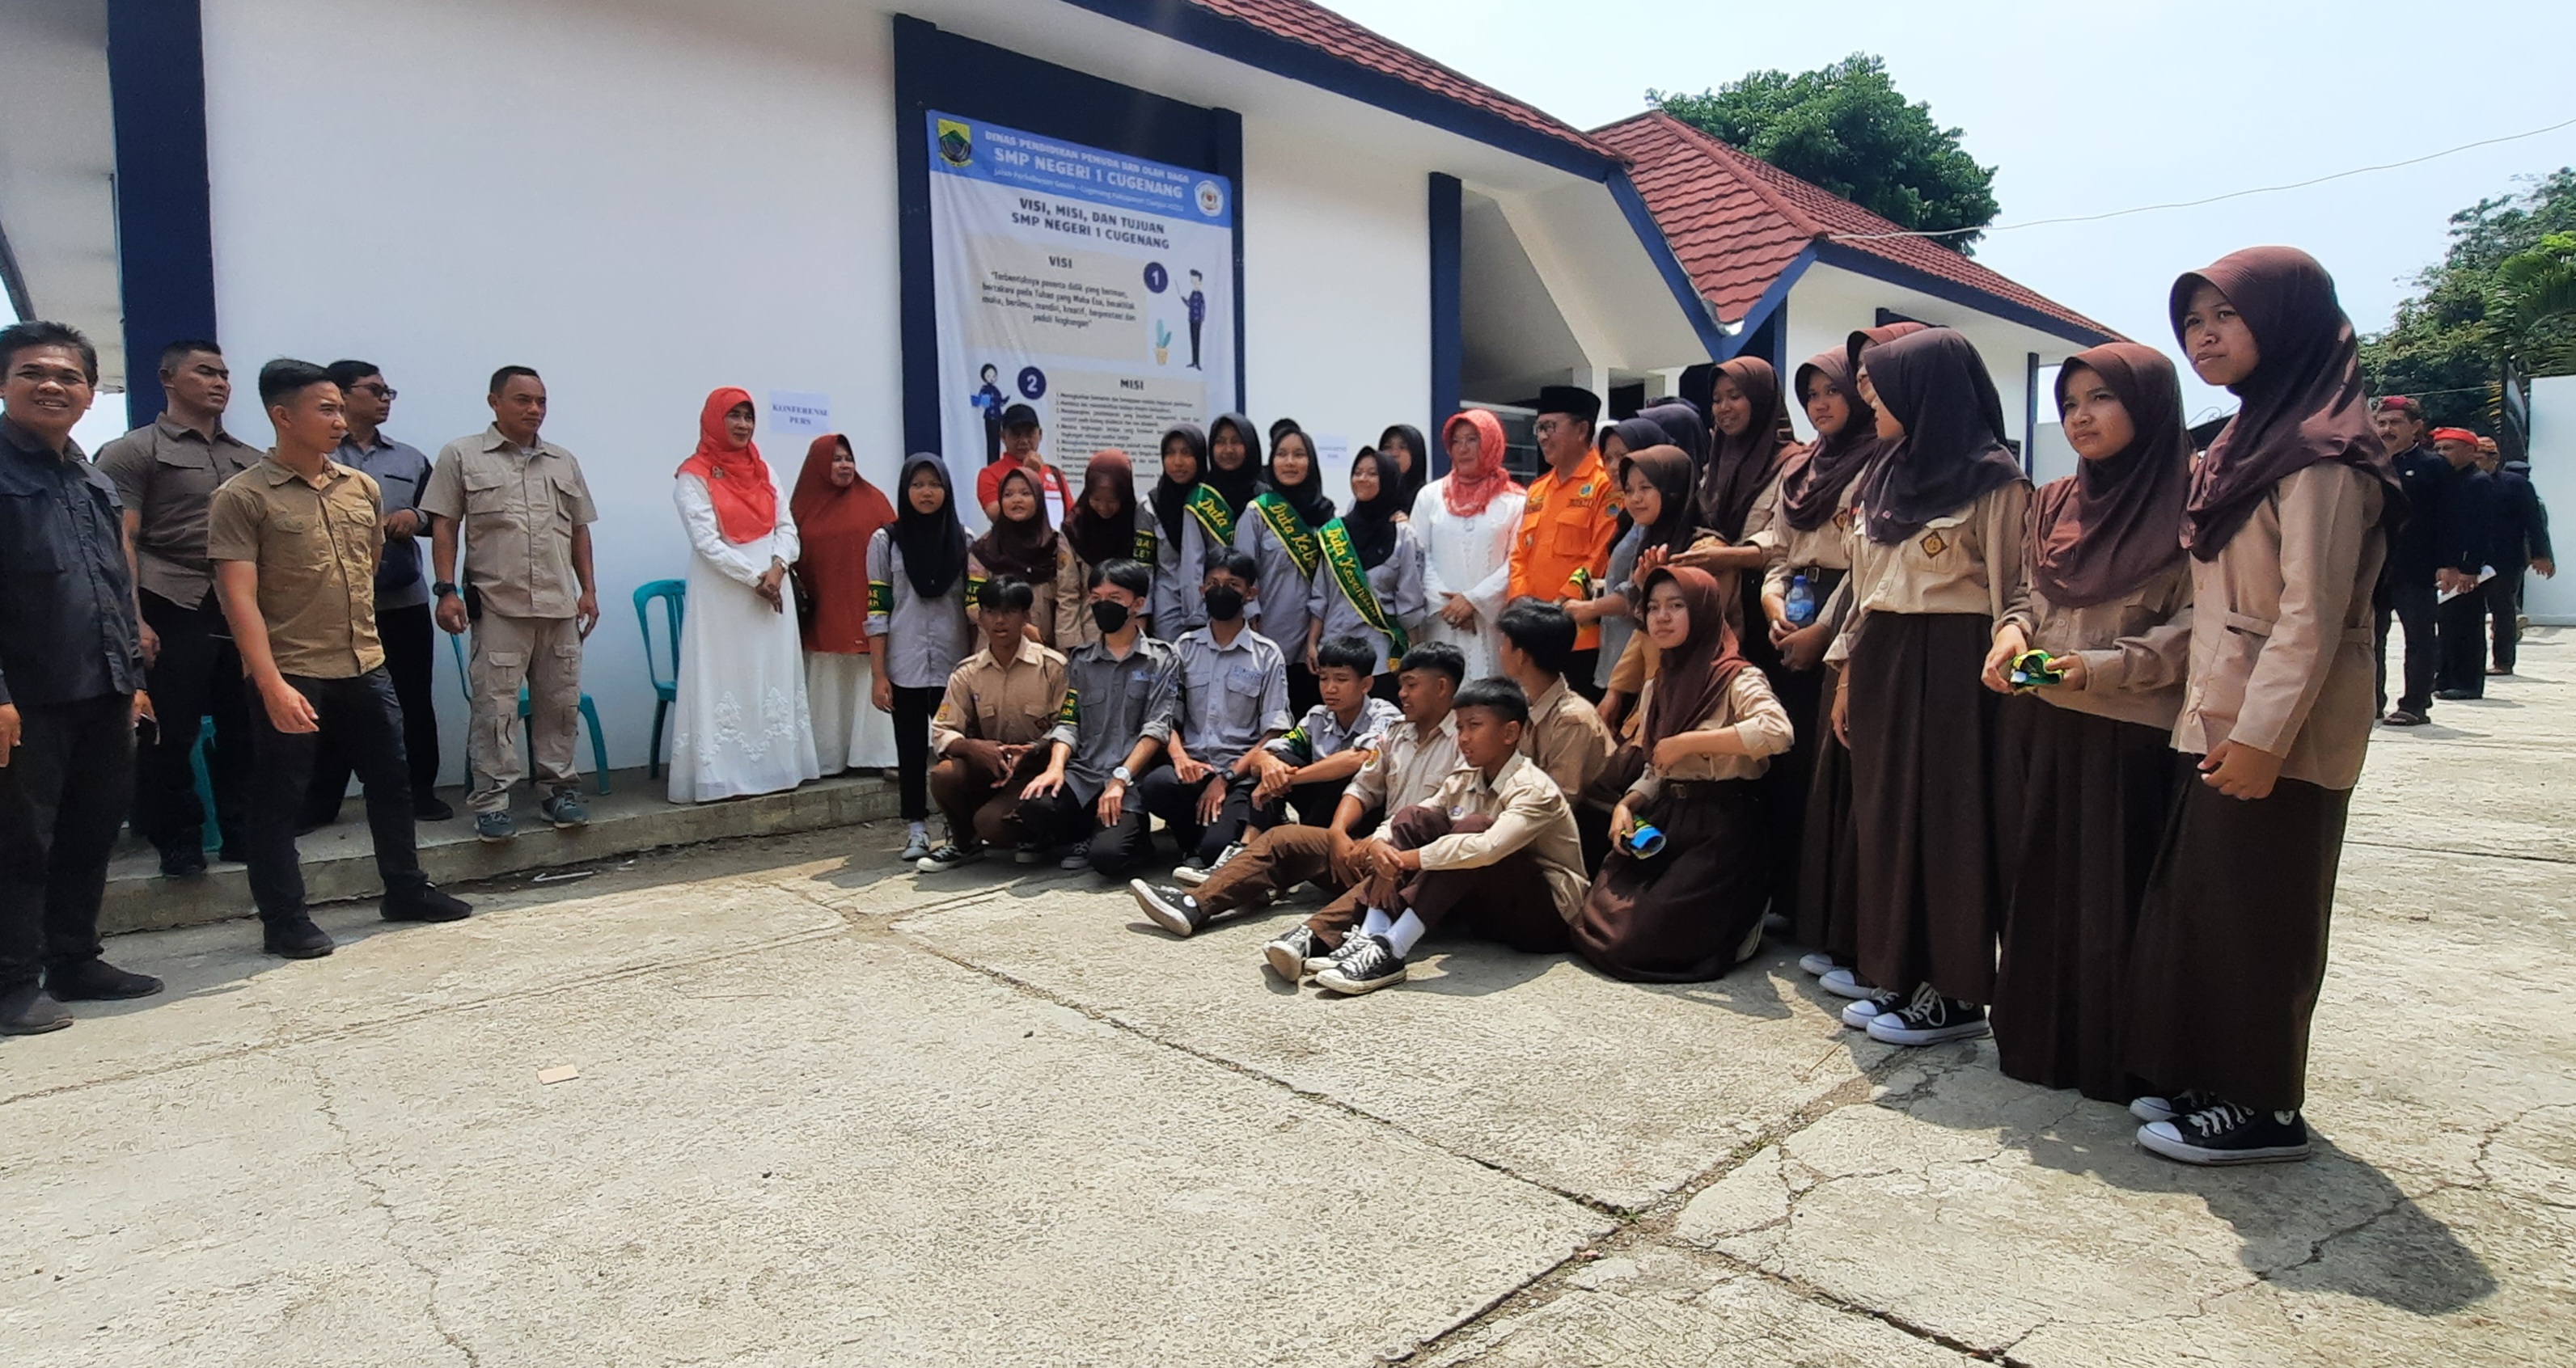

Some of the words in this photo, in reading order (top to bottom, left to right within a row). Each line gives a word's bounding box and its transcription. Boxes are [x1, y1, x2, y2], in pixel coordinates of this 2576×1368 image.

[994, 147, 1030, 167] SMP
[1034, 155, 1090, 179] NEGERI
[1096, 169, 1102, 182] 1
[1107, 171, 1183, 198] CUGENANG
[1019, 198, 1051, 215] VISI,
[1055, 205, 1088, 222] MISI,
[1092, 212, 1117, 225] DAN
[1121, 217, 1165, 234] TUJUAN
[1012, 213, 1039, 226] SMP
[1045, 218, 1091, 236] NEGERI
[1096, 227, 1101, 237] 1
[1106, 229, 1170, 249] CUGENANG
[1048, 255, 1072, 268] VISI
[1152, 269, 1159, 286] 1
[1027, 374, 1038, 392] 2
[1120, 379, 1144, 390] MISI
[772, 404, 827, 416] KONFERENSI
[789, 416, 811, 425] PERS
[1197, 497, 1228, 528] Duta
[1268, 502, 1296, 534] Duta
